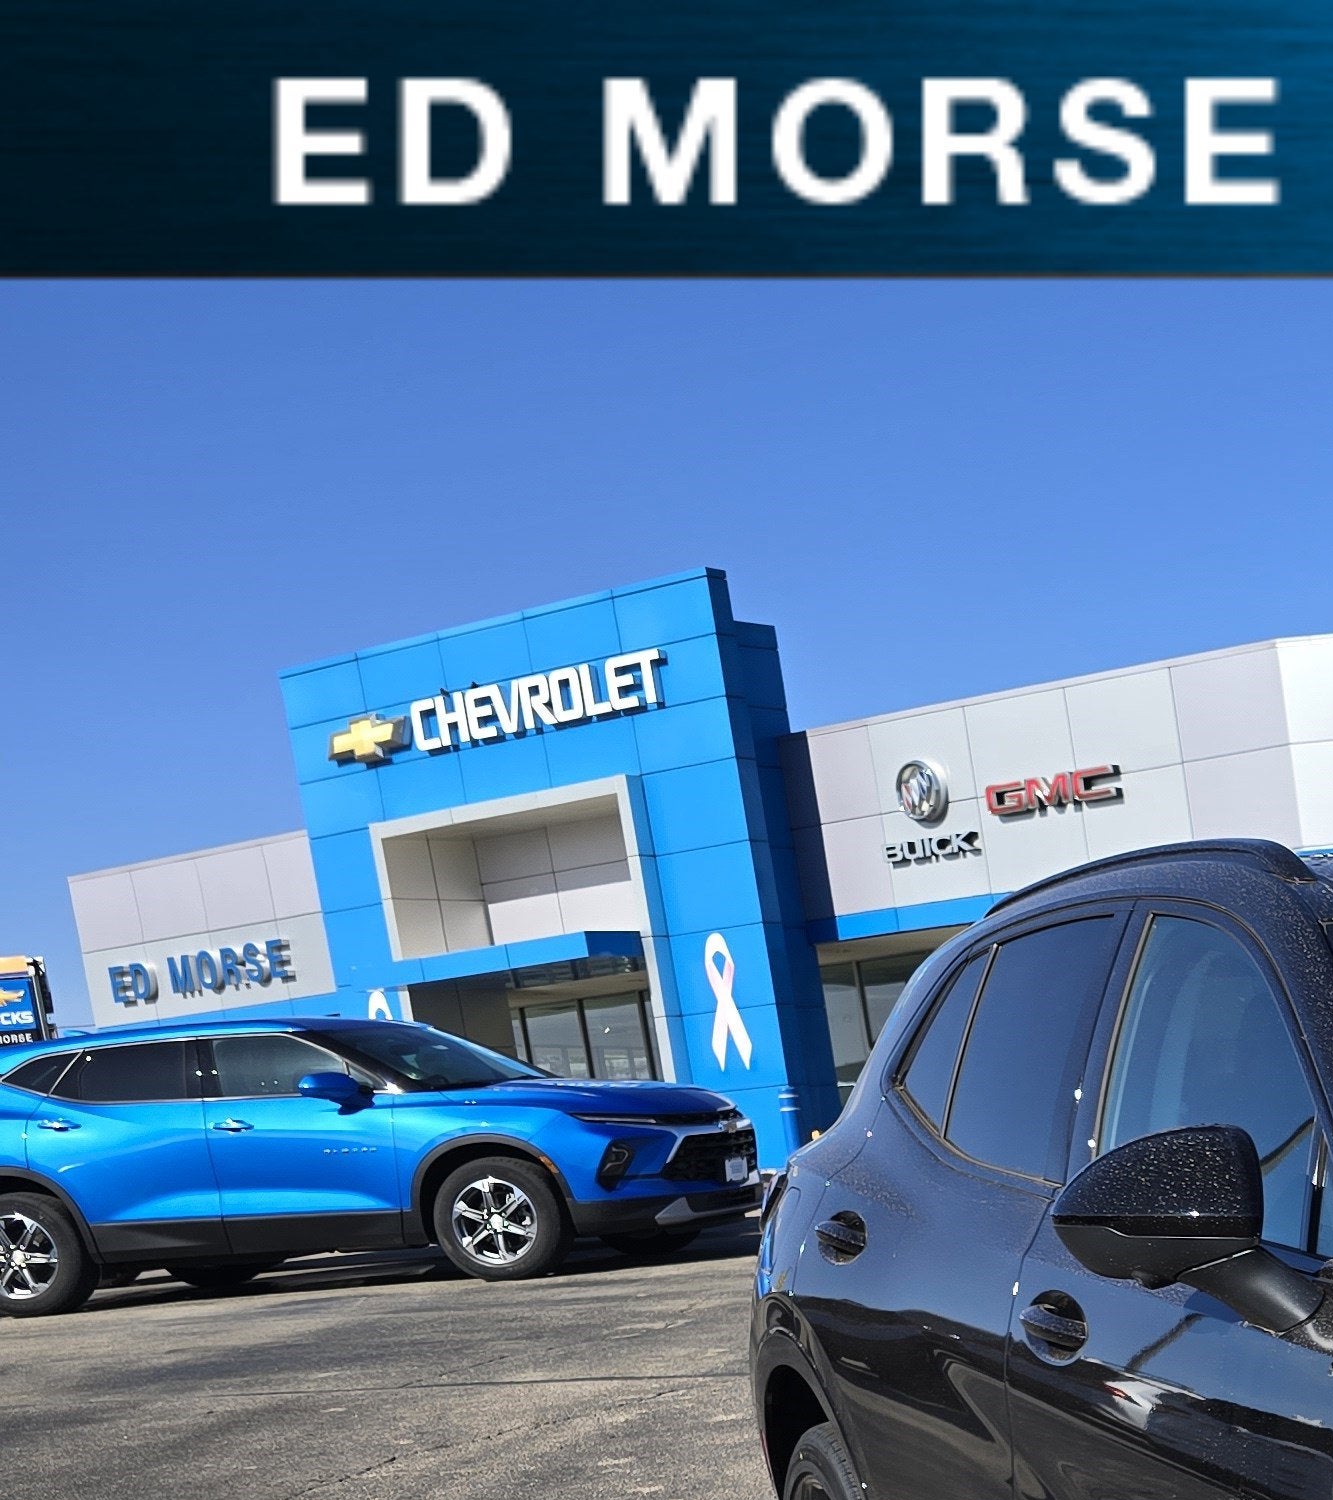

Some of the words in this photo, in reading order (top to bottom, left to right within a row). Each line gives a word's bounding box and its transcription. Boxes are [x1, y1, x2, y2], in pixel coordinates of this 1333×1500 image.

[410, 648, 668, 753] CHEVROLET
[985, 764, 1122, 817] GMC
[883, 831, 980, 864] BUICK
[108, 963, 159, 1005] ED
[166, 939, 296, 998] MORSE
